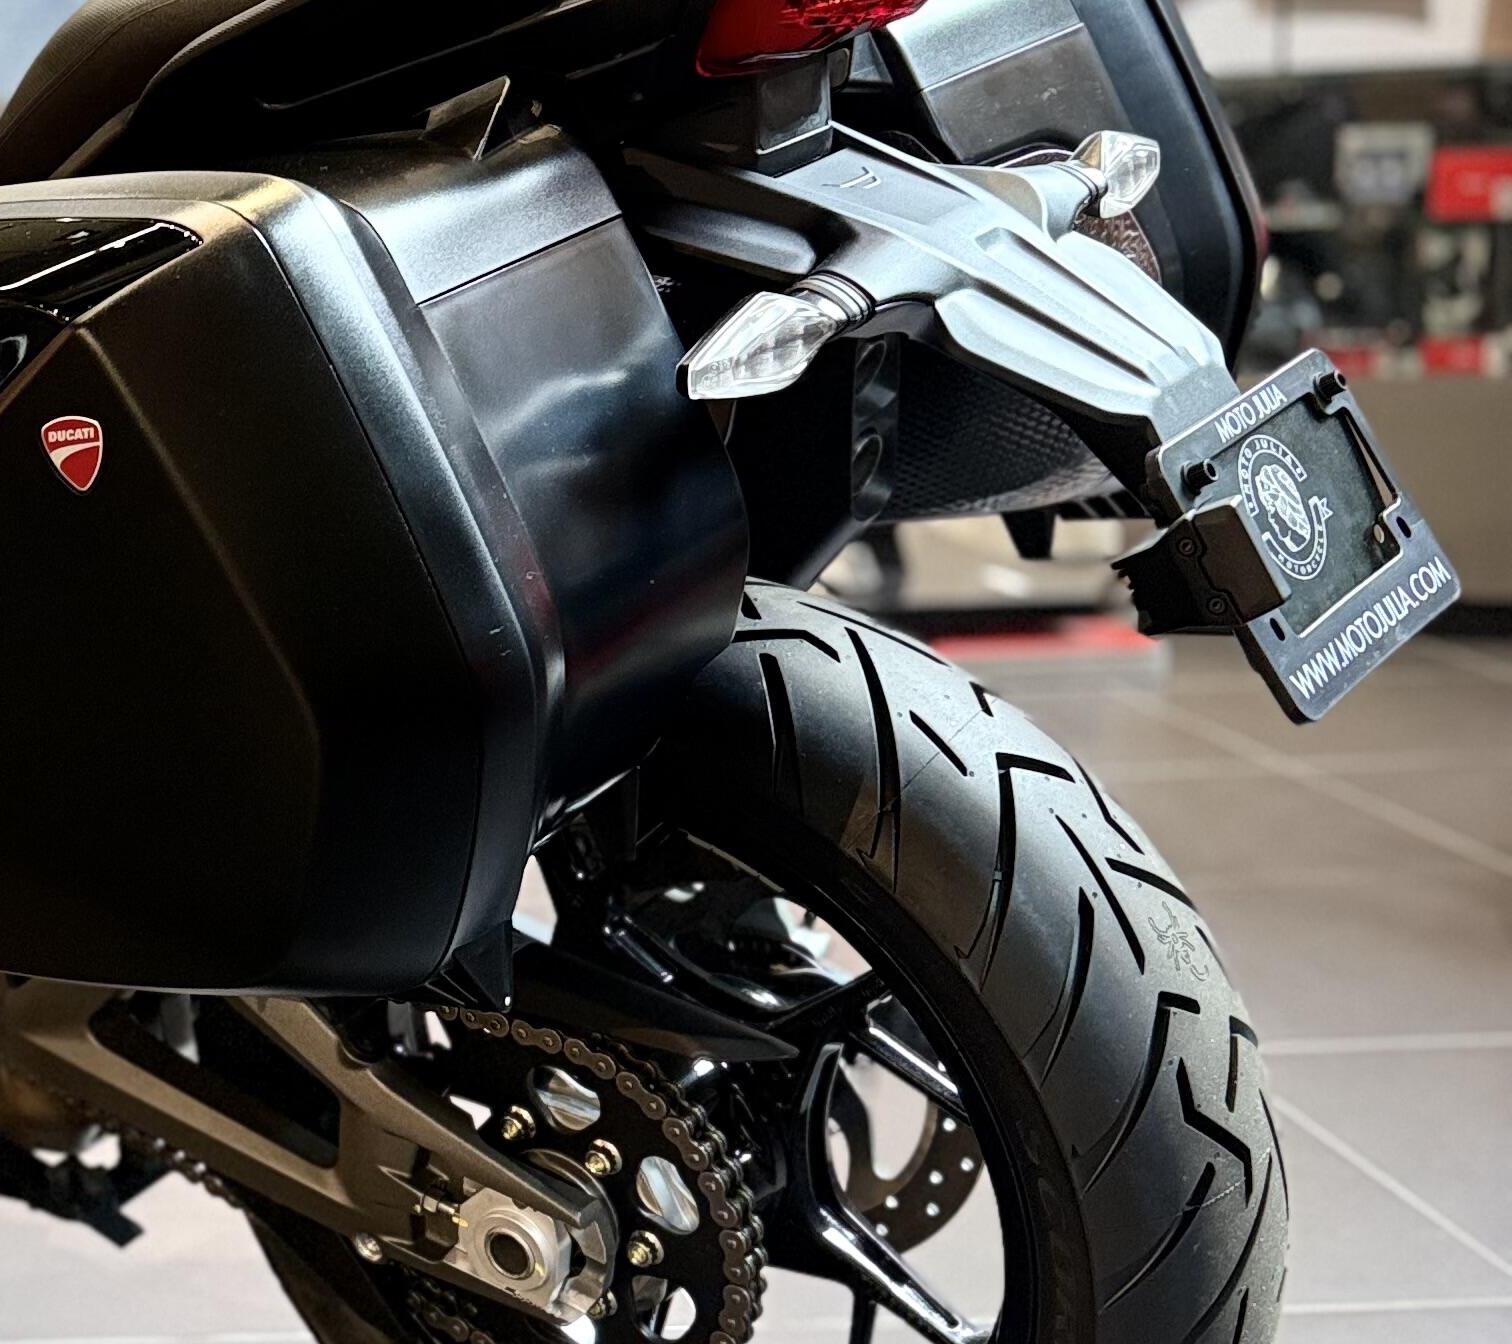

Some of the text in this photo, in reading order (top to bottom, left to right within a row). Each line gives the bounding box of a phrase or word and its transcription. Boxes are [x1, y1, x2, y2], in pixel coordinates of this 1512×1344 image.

[48, 427, 95, 443] DUCATI
[1214, 384, 1287, 444] MOTO JULIA
[1289, 556, 1452, 700] WWW.MOTOJULIA.COM
